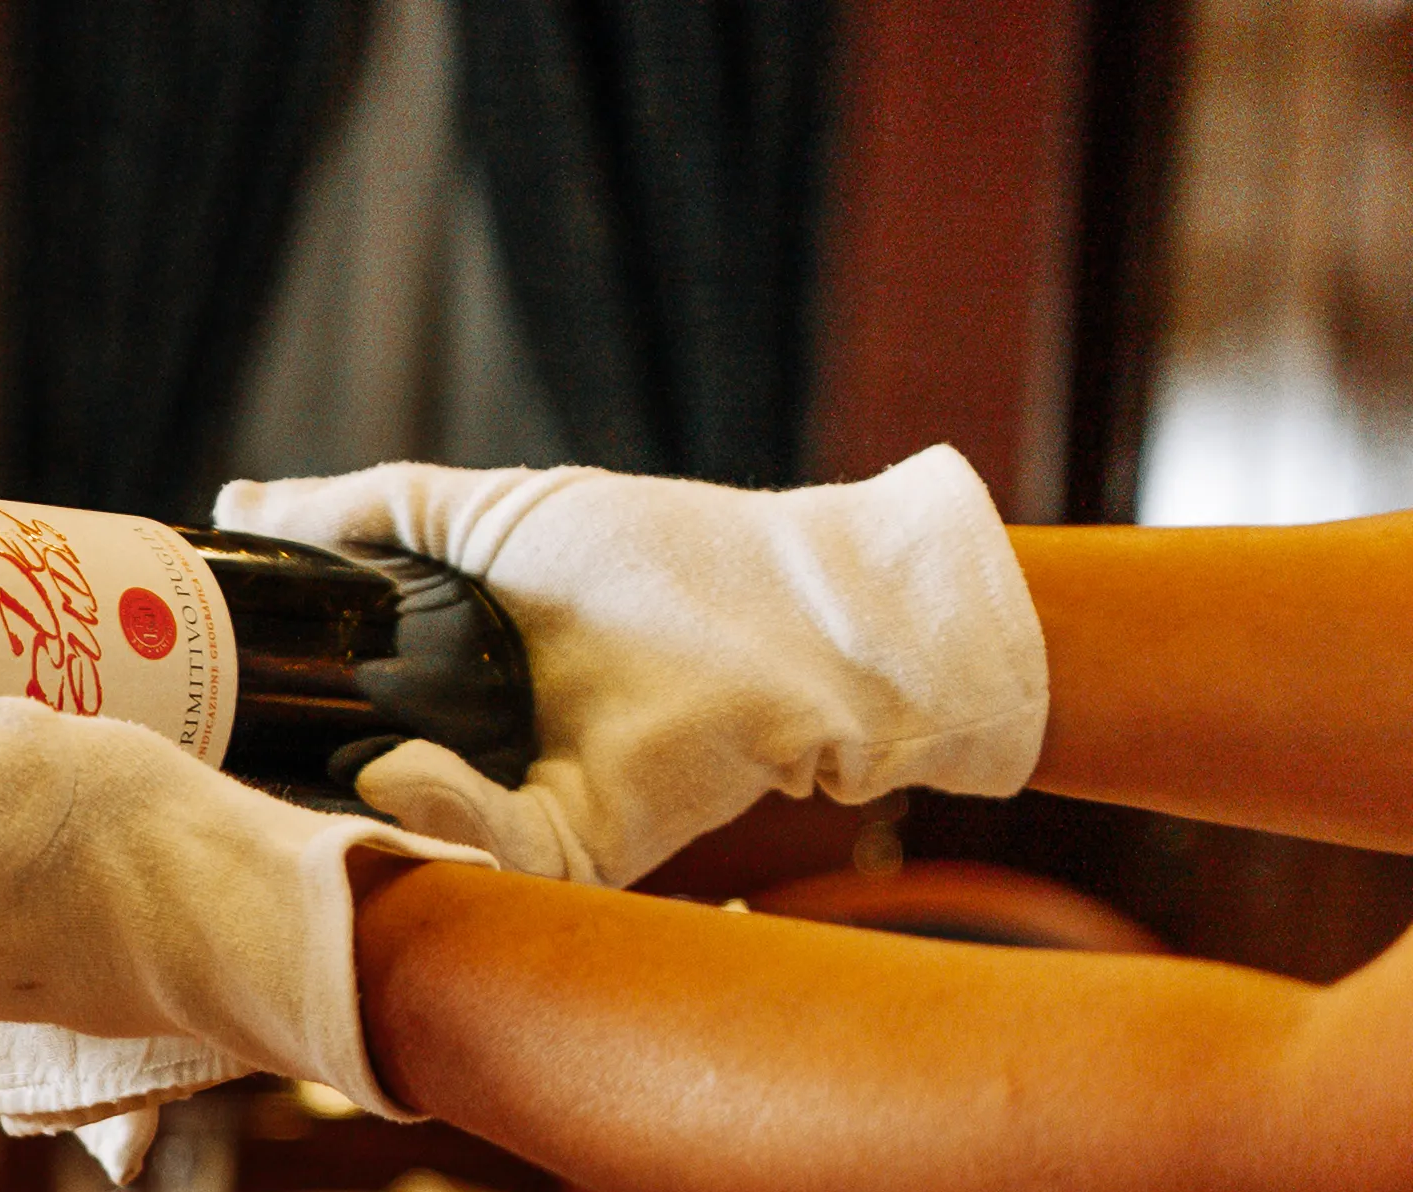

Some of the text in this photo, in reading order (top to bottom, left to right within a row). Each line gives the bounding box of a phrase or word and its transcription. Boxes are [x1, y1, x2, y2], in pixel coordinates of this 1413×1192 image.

[134, 527, 192, 597] PUGLIA
[193, 578, 218, 660] GEOGRAFICA
[180, 605, 205, 746] RIMITIVO
